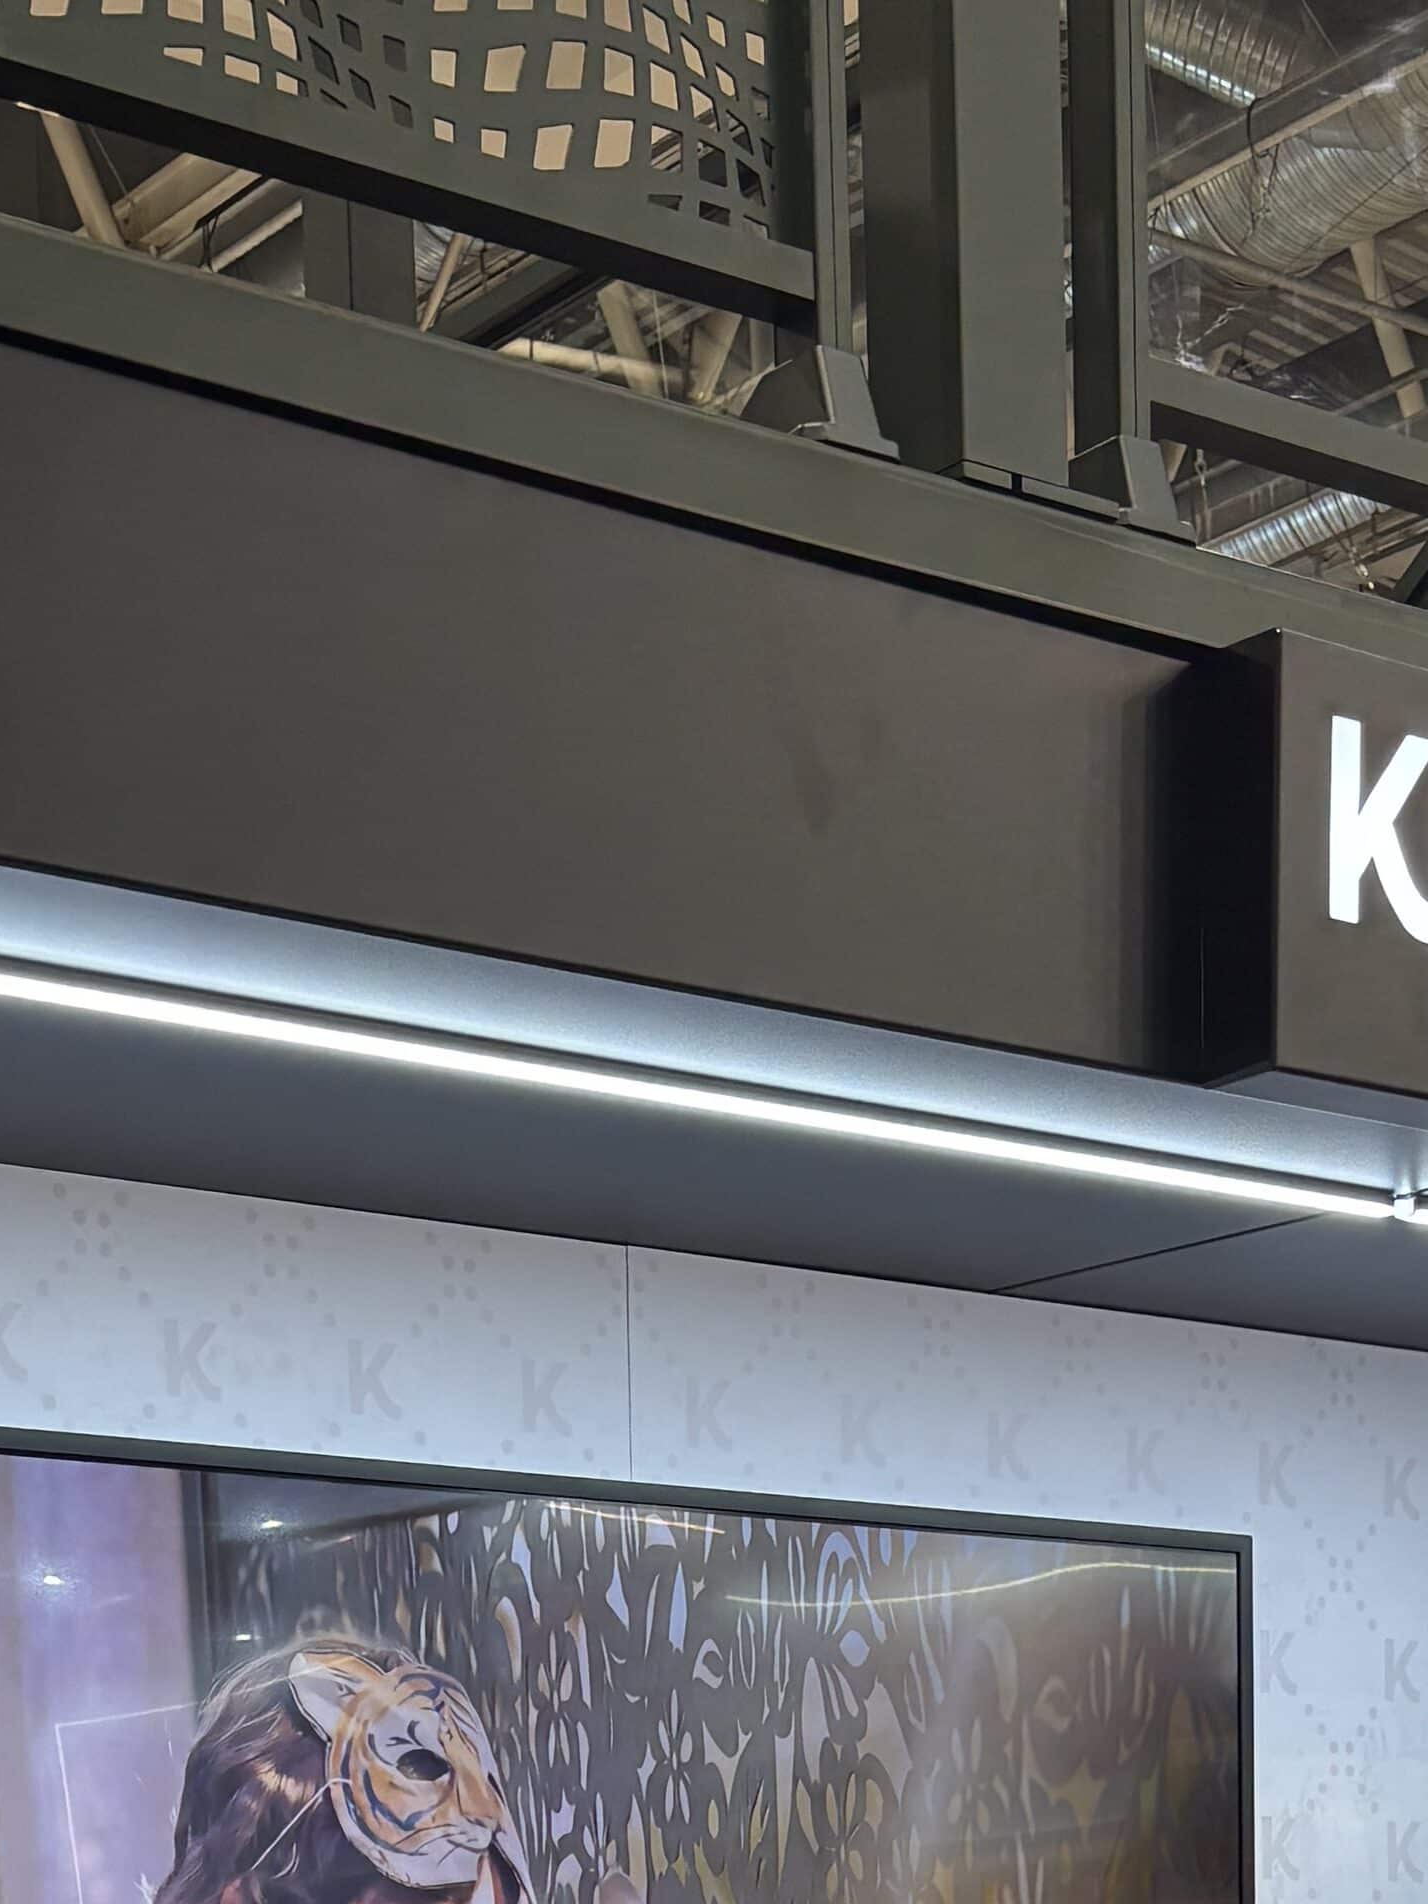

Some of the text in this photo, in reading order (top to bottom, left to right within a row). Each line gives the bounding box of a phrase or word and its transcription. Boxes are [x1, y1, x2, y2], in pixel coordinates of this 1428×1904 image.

[163, 1318, 223, 1401] K
[346, 1338, 402, 1421] K
[520, 1358, 568, 1437] K
[686, 1377, 733, 1452] K
[841, 1397, 887, 1469] K
[987, 1413, 1031, 1482] K
[1127, 1427, 1165, 1495] K
[1258, 1442, 1296, 1508] K
[1384, 1456, 1420, 1520] K
[1260, 1630, 1298, 1696] K
[1384, 1638, 1420, 1703] K
[1261, 1816, 1300, 1881] K
[1387, 1821, 1424, 1884] K
